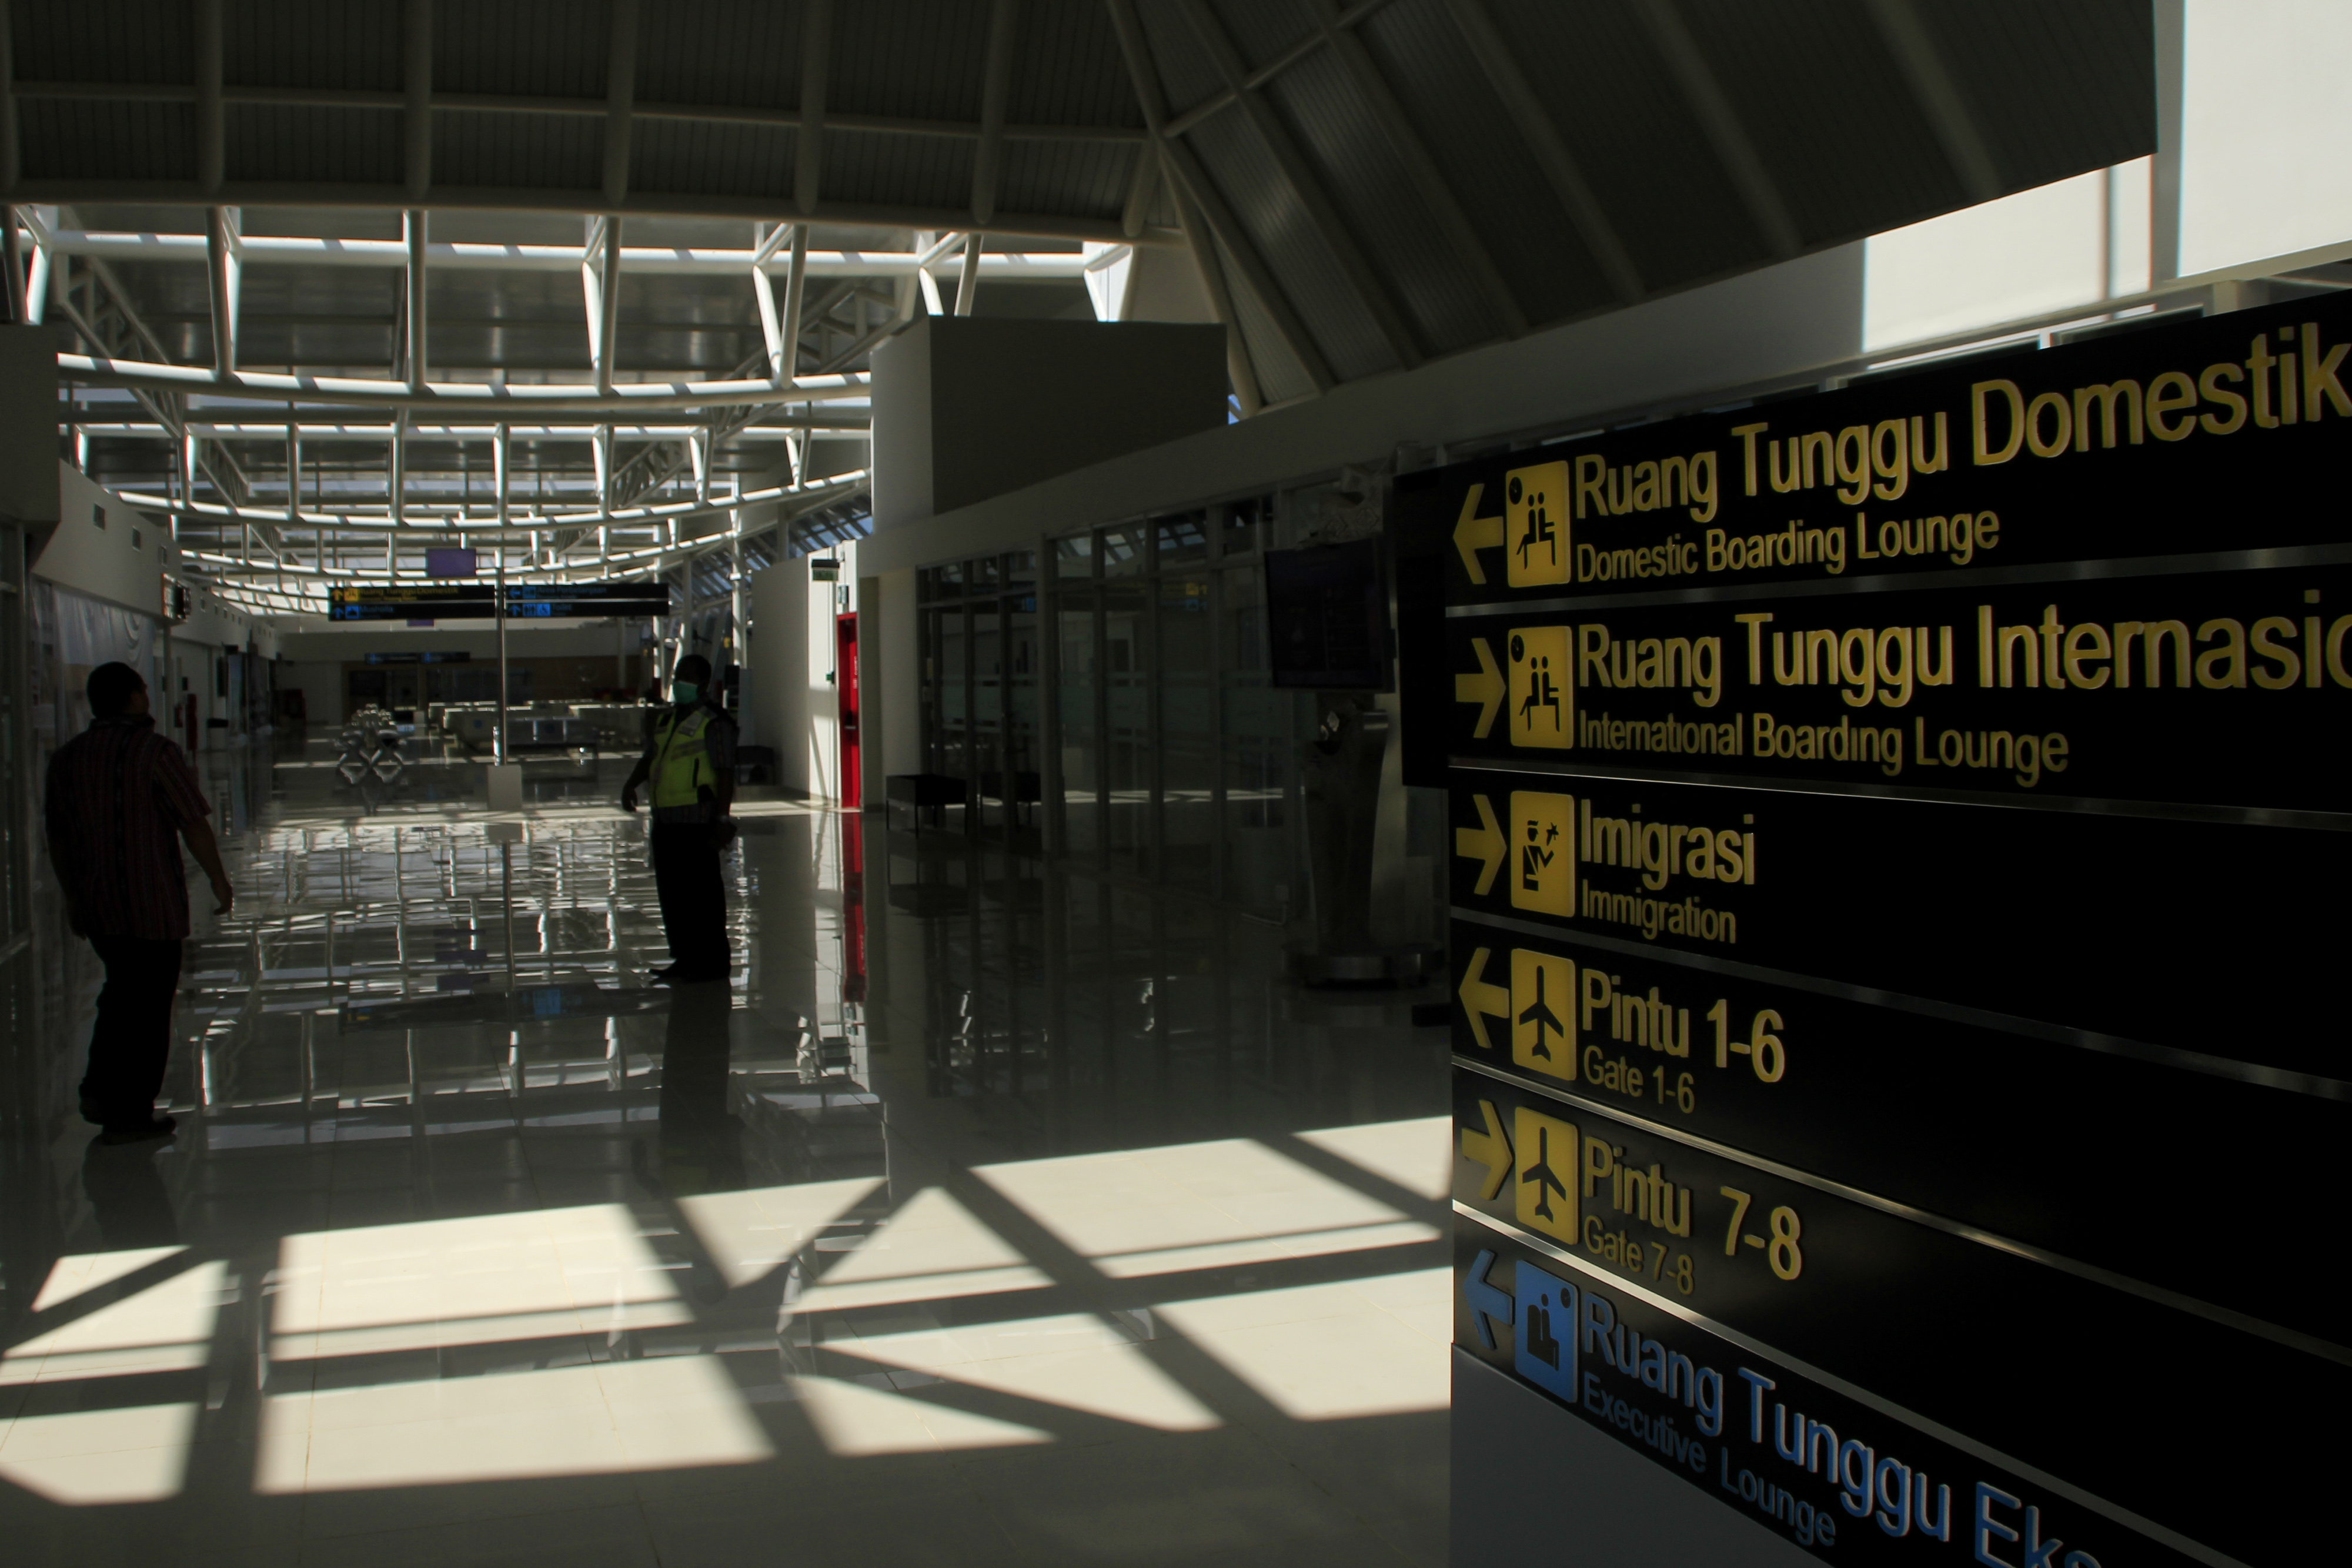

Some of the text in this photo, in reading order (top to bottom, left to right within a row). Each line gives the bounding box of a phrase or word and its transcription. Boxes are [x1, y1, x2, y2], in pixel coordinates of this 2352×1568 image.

[1576, 321, 2352, 523] Ruang Tunggu Domestik
[1577, 510, 2000, 583] Domestic Boarding Lounge
[1579, 623, 1722, 708] Ruang
[1735, 612, 1955, 708] Tunggu
[1580, 709, 2069, 788] International Boarding Lounge
[1581, 798, 1756, 891] Imigrasi
[1582, 878, 1737, 944] Immigration
[1582, 968, 1786, 1084] Pintu 1-6
[1583, 1045, 1696, 1114] Gate 1-6
[1583, 1136, 1803, 1281] Pintu 7-8
[1583, 1214, 1695, 1296] Gate 7-8
[1583, 1292, 1724, 1438] Ruang
[1737, 1366, 1953, 1543] Tunggu
[1583, 1370, 1838, 1547] Executive Lounge
